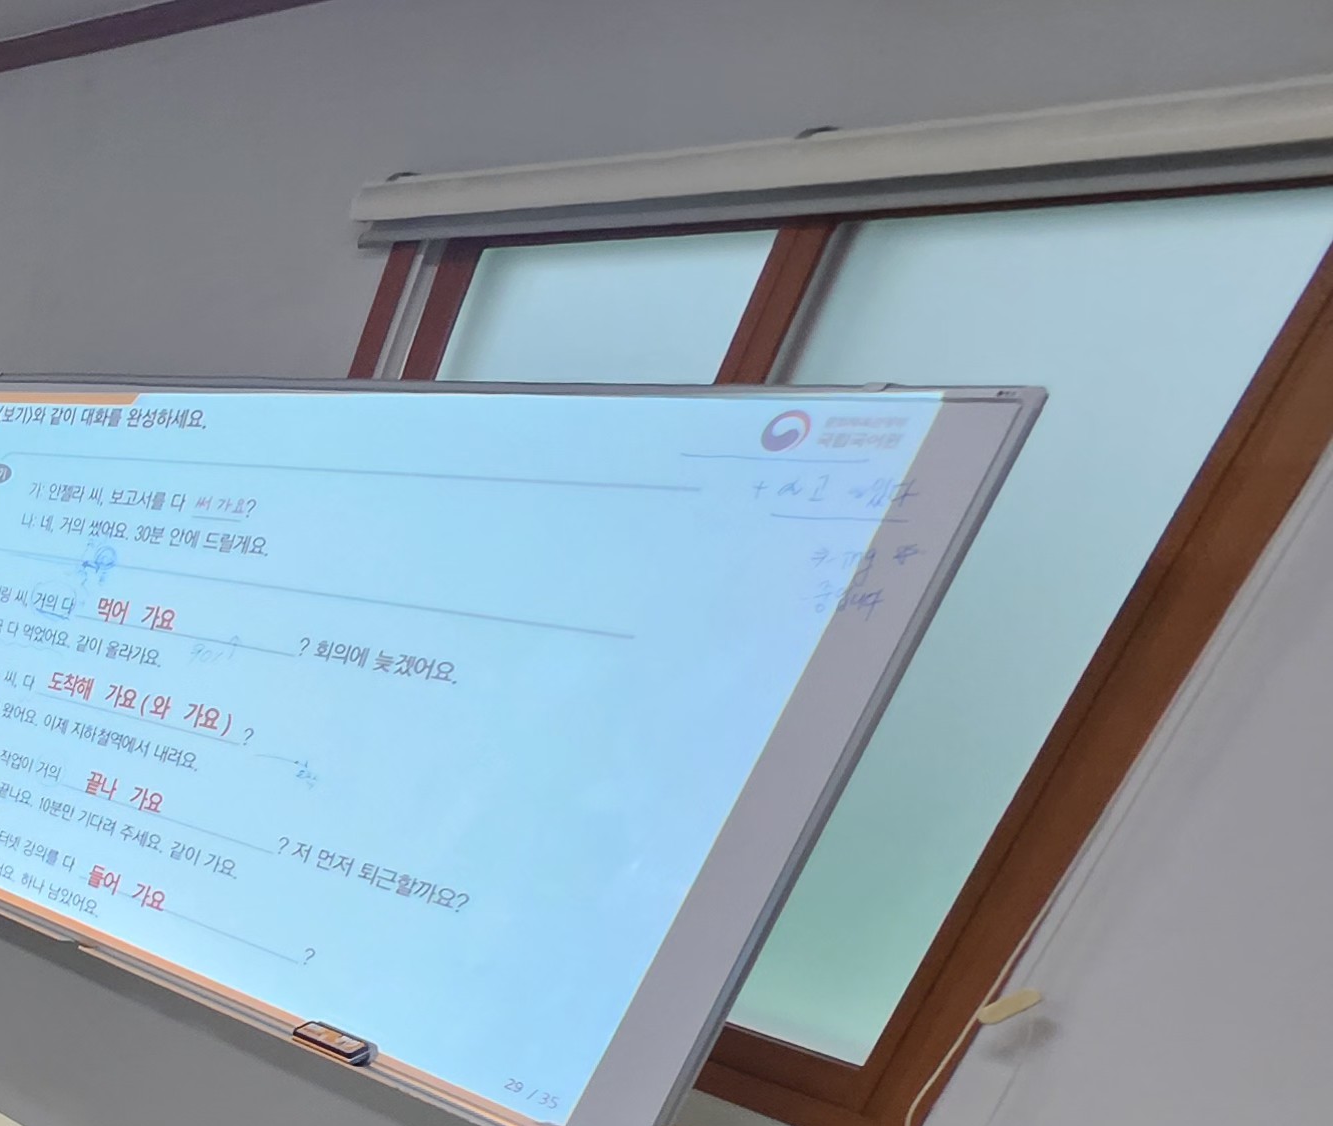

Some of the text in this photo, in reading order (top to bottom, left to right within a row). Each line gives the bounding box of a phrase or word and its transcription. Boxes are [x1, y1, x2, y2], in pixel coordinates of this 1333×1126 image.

[50, 407, 76, 425] 같이
[81, 408, 122, 427] 대화를
[127, 409, 207, 430] 완성하세요.
[29, 482, 46, 497] 가:
[49, 483, 84, 502] 안젤라
[88, 487, 104, 507] 씨,
[109, 489, 166, 511] 보고서를
[170, 493, 186, 512] 다
[21, 513, 35, 528] 나:
[41, 514, 54, 534] 네,
[59, 516, 83, 537] 거의
[134, 525, 165, 545] 30분
[169, 527, 200, 549] 안에
[202, 531, 269, 557] 드릴게요.
[7, 620, 20, 638] 다
[22, 623, 71, 649] 먹었어요.
[76, 634, 103, 655] 같이
[105, 639, 162, 669] 올라가요.
[15, 590, 28, 608] 씨,
[34, 592, 58, 611] 거의
[61, 596, 74, 613] 다
[97, 597, 130, 625] 먹어
[141, 605, 176, 631] 가요
[313, 639, 370, 668] 회의에
[372, 650, 459, 685] 늦겠어요.
[4, 669, 17, 688] 씨,
[23, 673, 35, 692] 다
[47, 671, 95, 702] 도착해
[2, 701, 39, 727] 왔어요.
[43, 714, 70, 735] 이제
[71, 721, 151, 758] 지하철역에서
[153, 743, 199, 772] 내려요.
[0, 749, 34, 773] 작업이
[36, 760, 62, 782] 거의
[85, 770, 118, 800] 끝나
[130, 785, 164, 814] 가요
[291, 841, 313, 864] 저
[316, 848, 355, 877] 먼저
[358, 861, 471, 914] 퇴근할까요?
[39, 796, 75, 821] 10분만
[78, 810, 117, 837] 기다려
[120, 823, 163, 855] 주세요.
[170, 841, 201, 866] 같이
[203, 852, 238, 880] 가요.
[21, 870, 45, 895] 하나
[47, 883, 99, 918] 남았어요.
[23, 838, 60, 867] 강의를
[62, 854, 76, 872] 다
[87, 864, 121, 896] 들어
[132, 883, 166, 912] 가요
[504, 1078, 525, 1093] 29
[538, 1092, 560, 1110] 35
